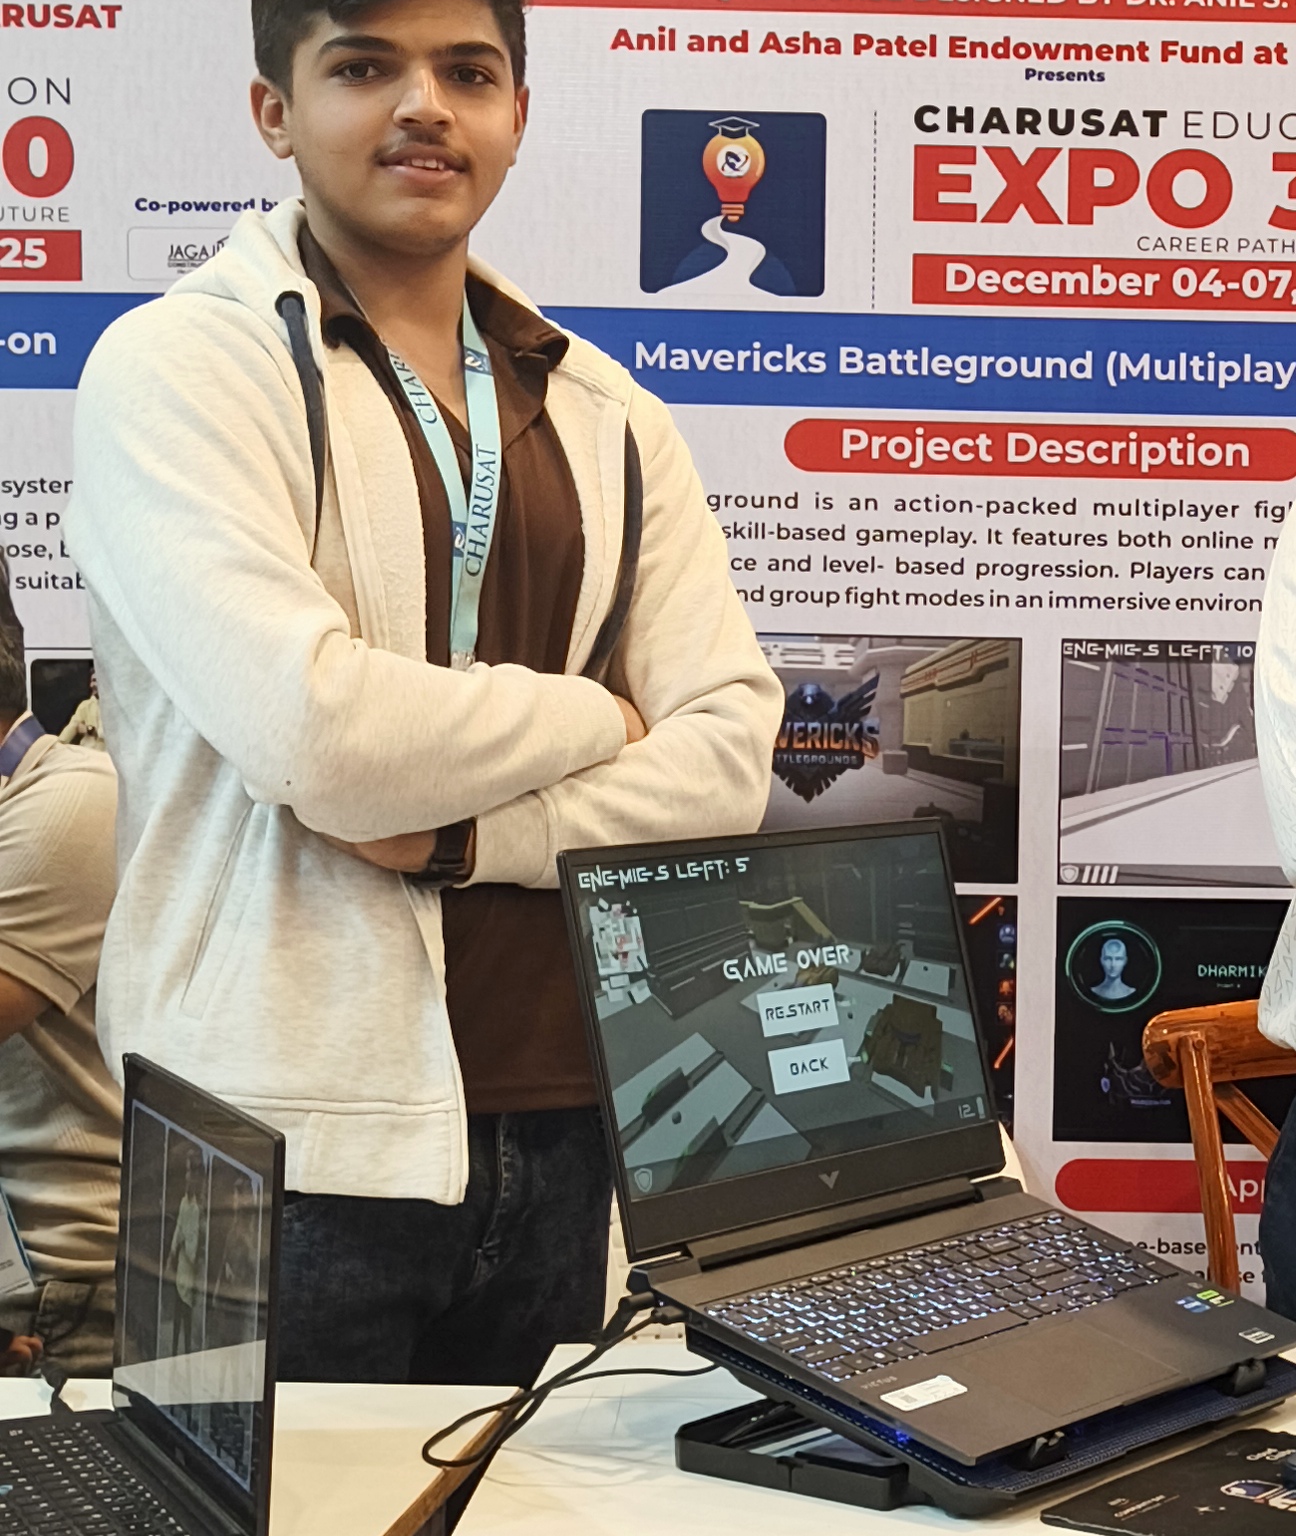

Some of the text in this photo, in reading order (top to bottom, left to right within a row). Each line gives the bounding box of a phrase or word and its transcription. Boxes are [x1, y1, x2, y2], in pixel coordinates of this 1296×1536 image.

[0, 3, 122, 29] RUSAT
[610, 26, 677, 51] Anil
[687, 30, 749, 54] and
[759, 31, 842, 56] Asha
[853, 33, 937, 58] Patel
[948, 36, 1150, 62] Endowment
[1160, 41, 1244, 65] Fund
[1253, 43, 1289, 65] at
[1025, 68, 1106, 83] Presents
[914, 104, 1168, 139] CHARUSAT
[913, 144, 1233, 229] EXPO
[134, 197, 255, 215] Co-powered
[1136, 235, 1229, 253] CAREER
[1237, 237, 1296, 254] PATH
[945, 263, 1160, 298] December
[634, 341, 827, 374] Mavericks
[838, 346, 1094, 384] Battleground
[841, 427, 1250, 473] Project Description
[25, 511, 39, 526] a
[465, 443, 497, 577] CHARUSAT
[814, 491, 834, 511] is
[848, 497, 879, 511] an
[893, 494, 1078, 518] action-packed
[1092, 498, 1240, 522] multiplayer
[721, 521, 1254, 550] skill-based gameplay. It features both online
[767, 554, 812, 573] and
[822, 554, 885, 574] level-
[895, 556, 965, 576] based
[976, 559, 1120, 582] progression.
[1130, 561, 1214, 584] Players
[1223, 566, 1266, 581] can
[769, 588, 841, 608] group
[845, 586, 901, 609] fight
[905, 588, 985, 608] modes
[989, 589, 1010, 608] in
[1015, 594, 1043, 609] an
[1049, 591, 1171, 611] immersive
[1168, 643, 1230, 661] LEFT:
[1236, 645, 1254, 658] 10
[775, 718, 880, 760] VERICKS
[675, 859, 731, 880] LEFT:
[735, 856, 751, 872] 5
[723, 944, 851, 983] GAME OVER
[765, 997, 831, 1022] RESTART
[789, 1057, 829, 1076] BACK
